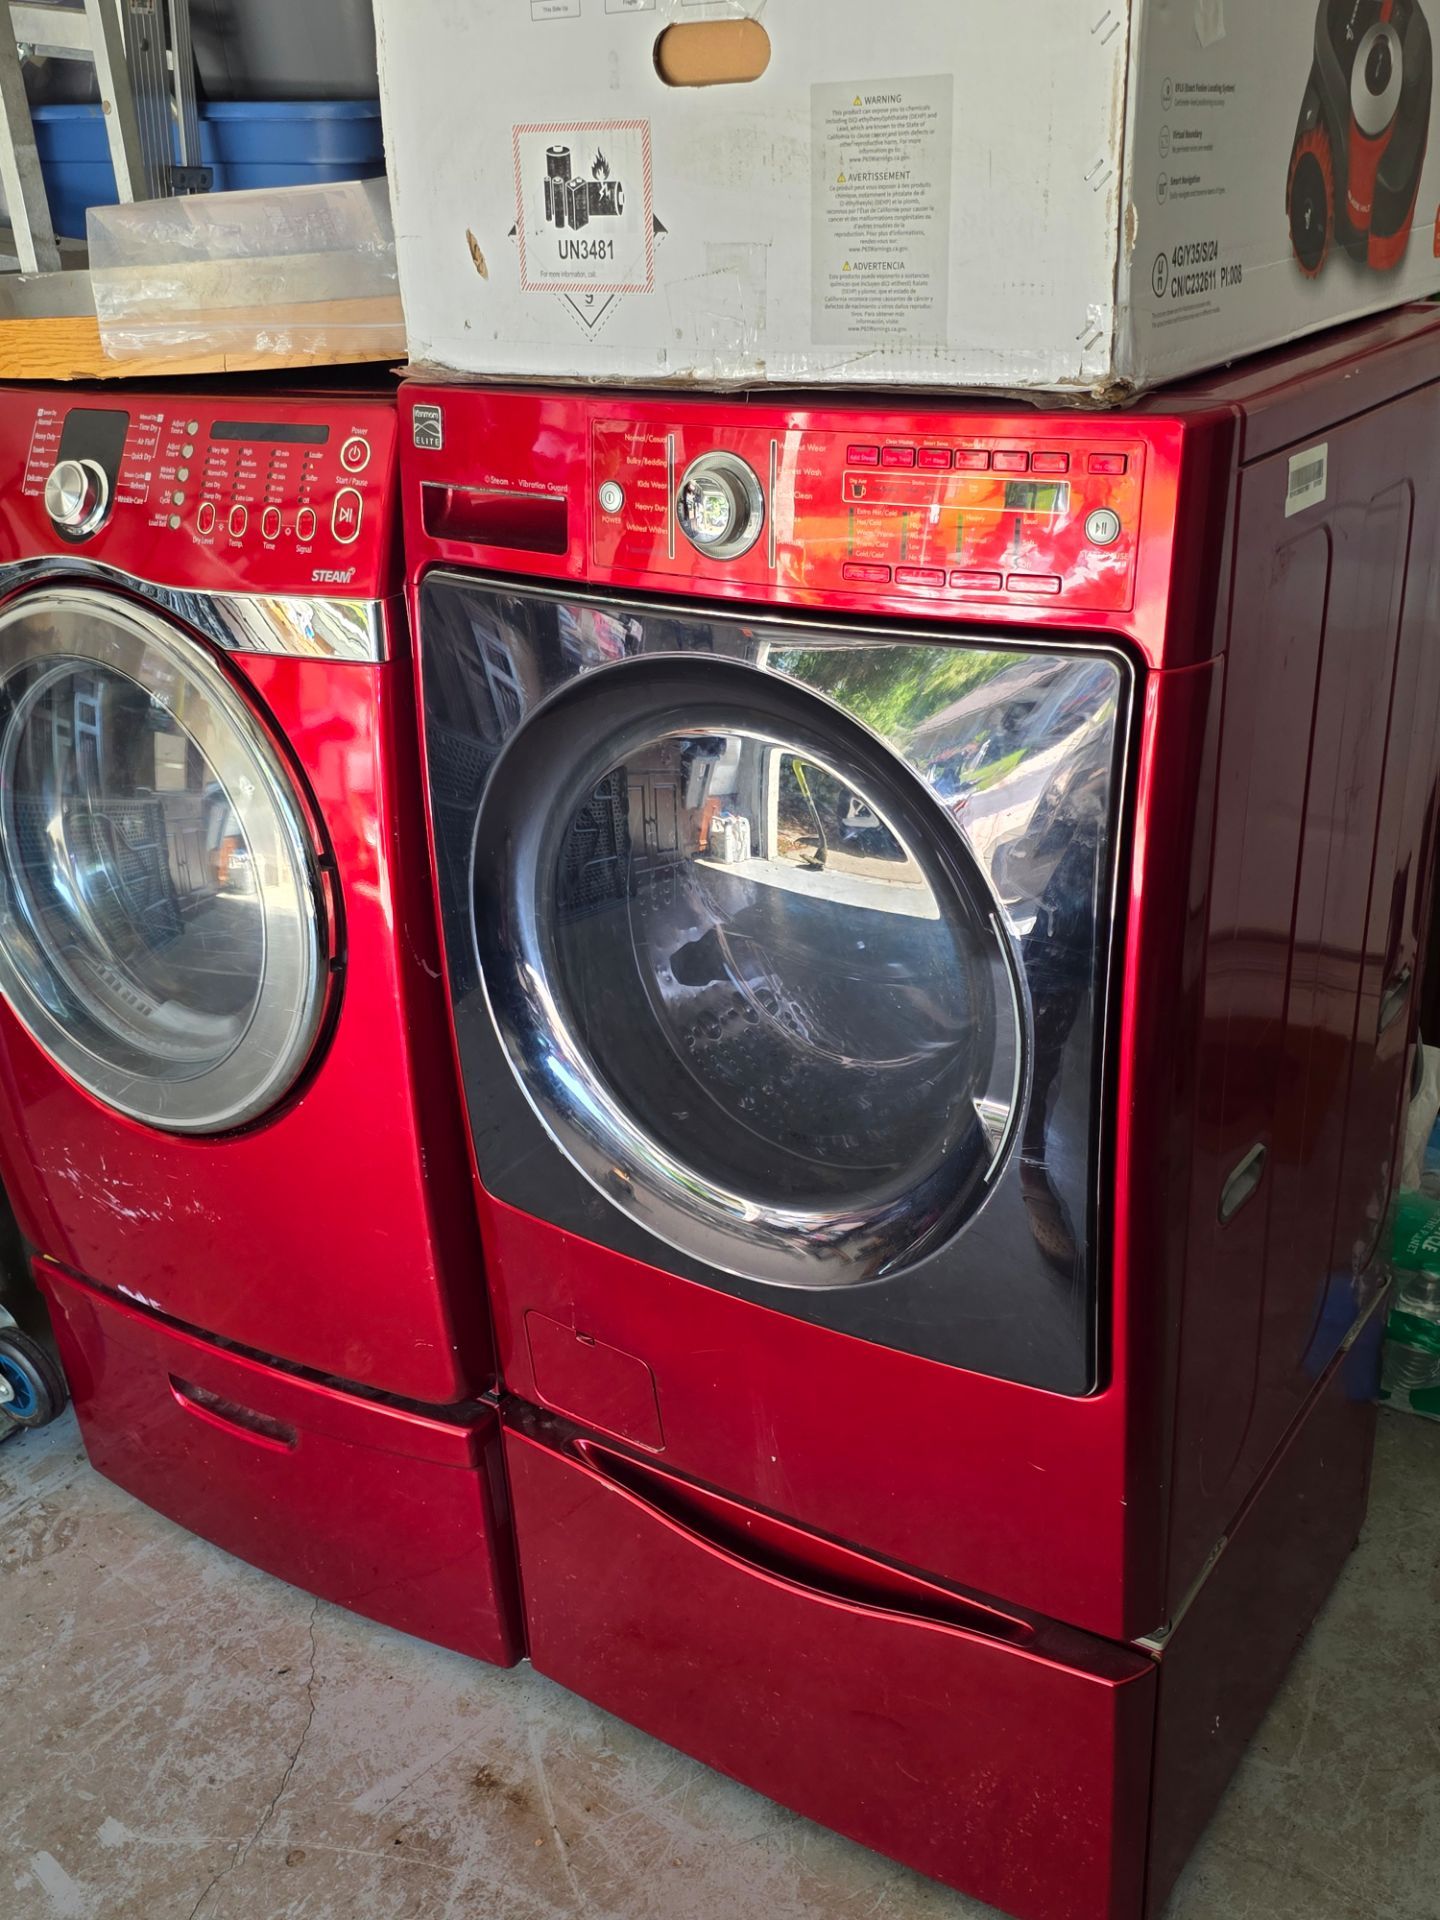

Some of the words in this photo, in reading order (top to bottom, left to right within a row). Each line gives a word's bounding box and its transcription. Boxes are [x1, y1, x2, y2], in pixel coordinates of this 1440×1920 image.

[864, 94, 902, 105] WARNING
[848, 171, 910, 182] AVERTISSEMENT
[558, 239, 614, 260] UN3481
[853, 261, 905, 271] ADVERTENCIA
[1171, 269, 1217, 298] CN/C232611
[138, 423, 150, 431] Time
[150, 424, 158, 433] Dry
[351, 426, 369, 435] Power
[416, 436, 440, 447] ELITE
[131, 452, 143, 461] Quick
[143, 453, 152, 462] Dry
[803, 467, 822, 477] Wash
[336, 476, 348, 485] Start
[351, 478, 368, 487] Pause
[490, 475, 509, 486] Steam
[518, 479, 546, 489] Vibration
[547, 482, 569, 493] Guard
[637, 480, 650, 489] Kids
[651, 481, 668, 490] Wear
[159, 496, 171, 505] Cycle
[635, 502, 654, 513] Heavy
[655, 503, 668, 513] Duty
[602, 515, 621, 525] POWER
[193, 536, 202, 545] Dry
[263, 541, 276, 551] Time
[296, 544, 313, 554] Signal
[311, 569, 352, 584] STEAM
